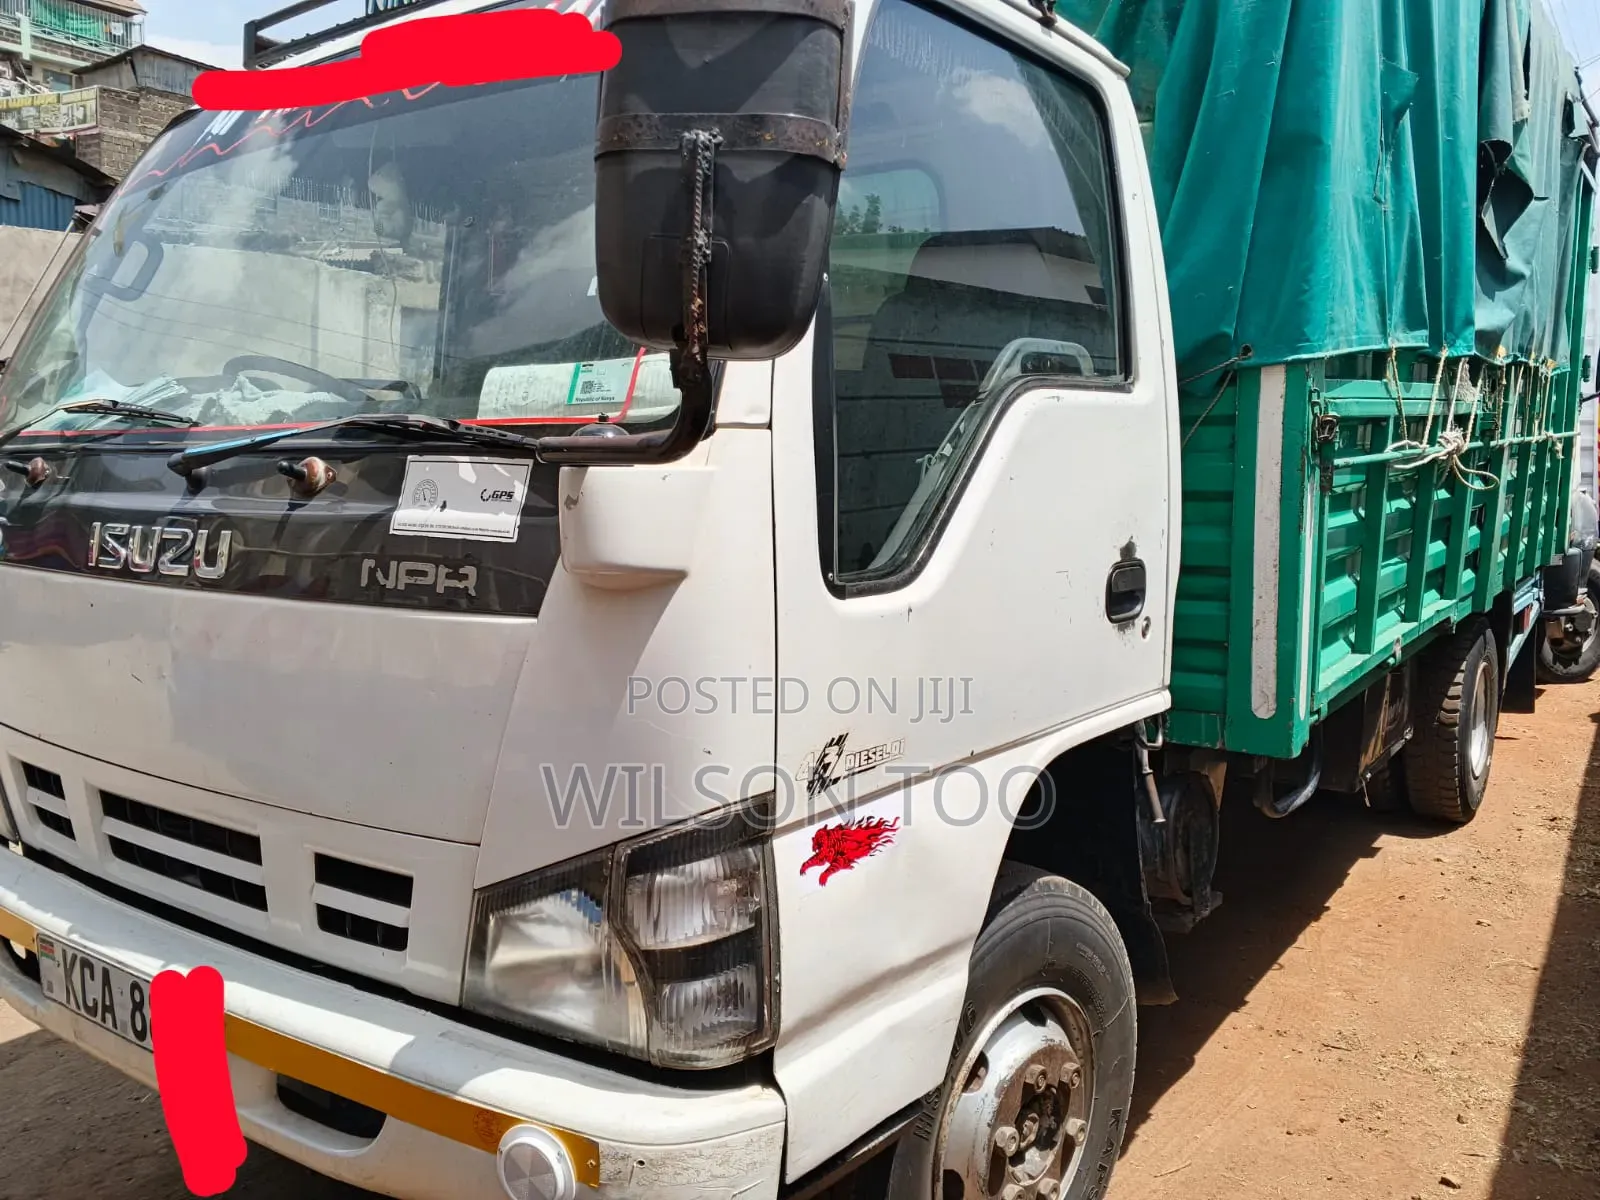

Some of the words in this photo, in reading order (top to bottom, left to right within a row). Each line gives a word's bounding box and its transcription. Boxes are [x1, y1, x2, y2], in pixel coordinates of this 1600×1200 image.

[491, 490, 515, 500] GPS
[88, 521, 232, 579] ISUZU
[360, 558, 477, 597] NPR
[845, 743, 891, 771] DIESEL
[62, 948, 118, 1030] KCA
